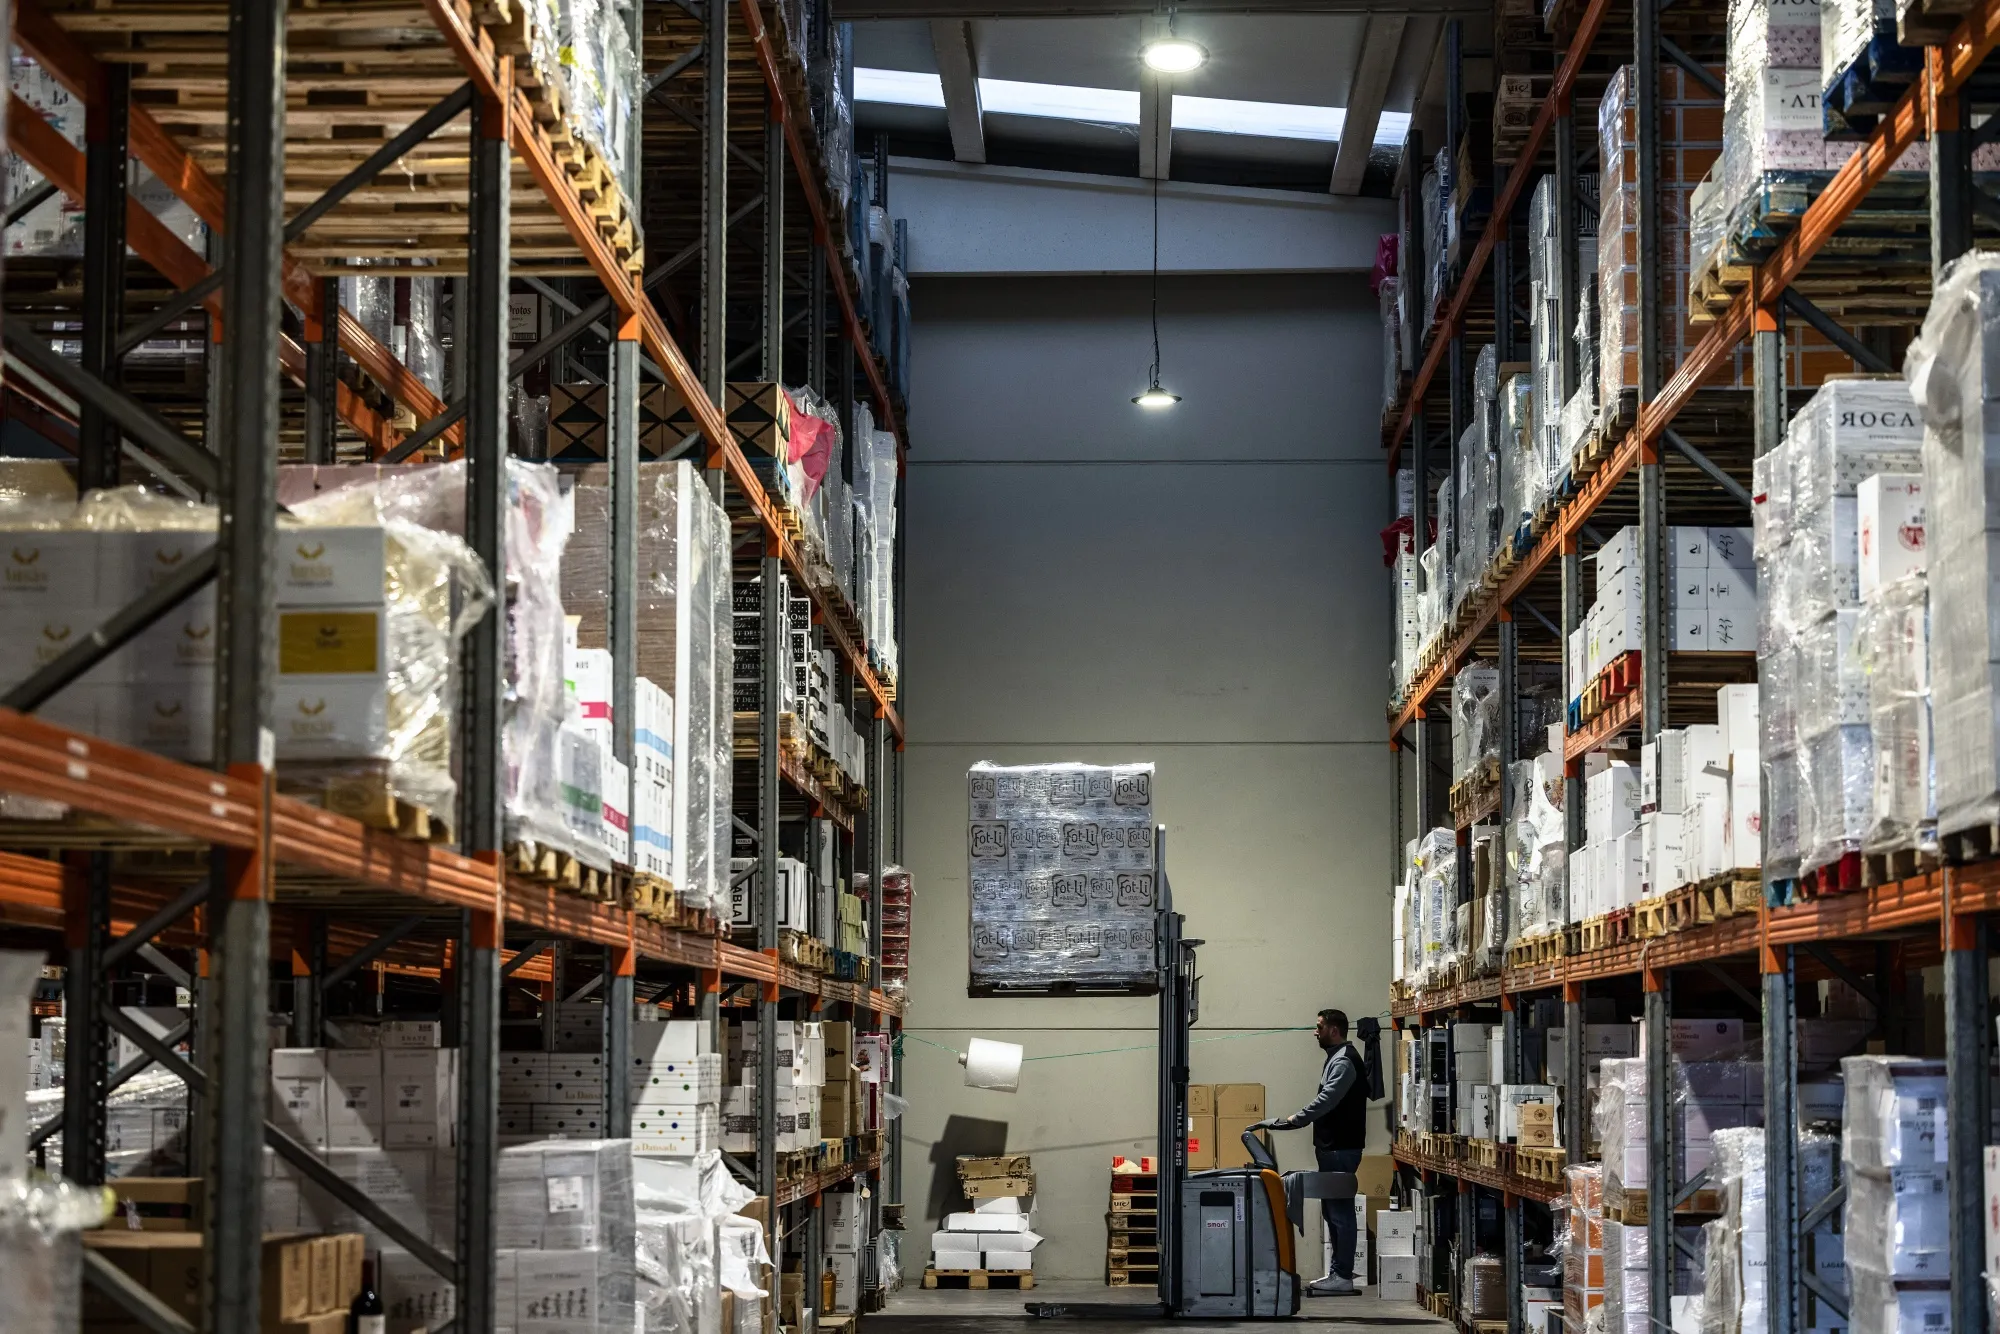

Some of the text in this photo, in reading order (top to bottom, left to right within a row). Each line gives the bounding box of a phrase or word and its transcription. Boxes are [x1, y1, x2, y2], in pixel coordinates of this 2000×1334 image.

[973, 780, 992, 793] Fot-Li
[1117, 777, 1145, 796] Fot-Li
[974, 828, 1002, 848] Fot-Li
[1012, 829, 1031, 842] Fot-Li
[1066, 826, 1095, 847] Fot-Li
[1102, 829, 1122, 842] Fot-Li
[1129, 829, 1149, 842] Fot-Li
[1054, 878, 1082, 898] Fot-Li
[1091, 881, 1111, 894] Fot-Li
[1120, 879, 1147, 898] Fot-Li
[732, 886, 742, 918] ABLA
[976, 930, 1005, 949] Fot-Li
[1132, 931, 1152, 944] Fot-Li
